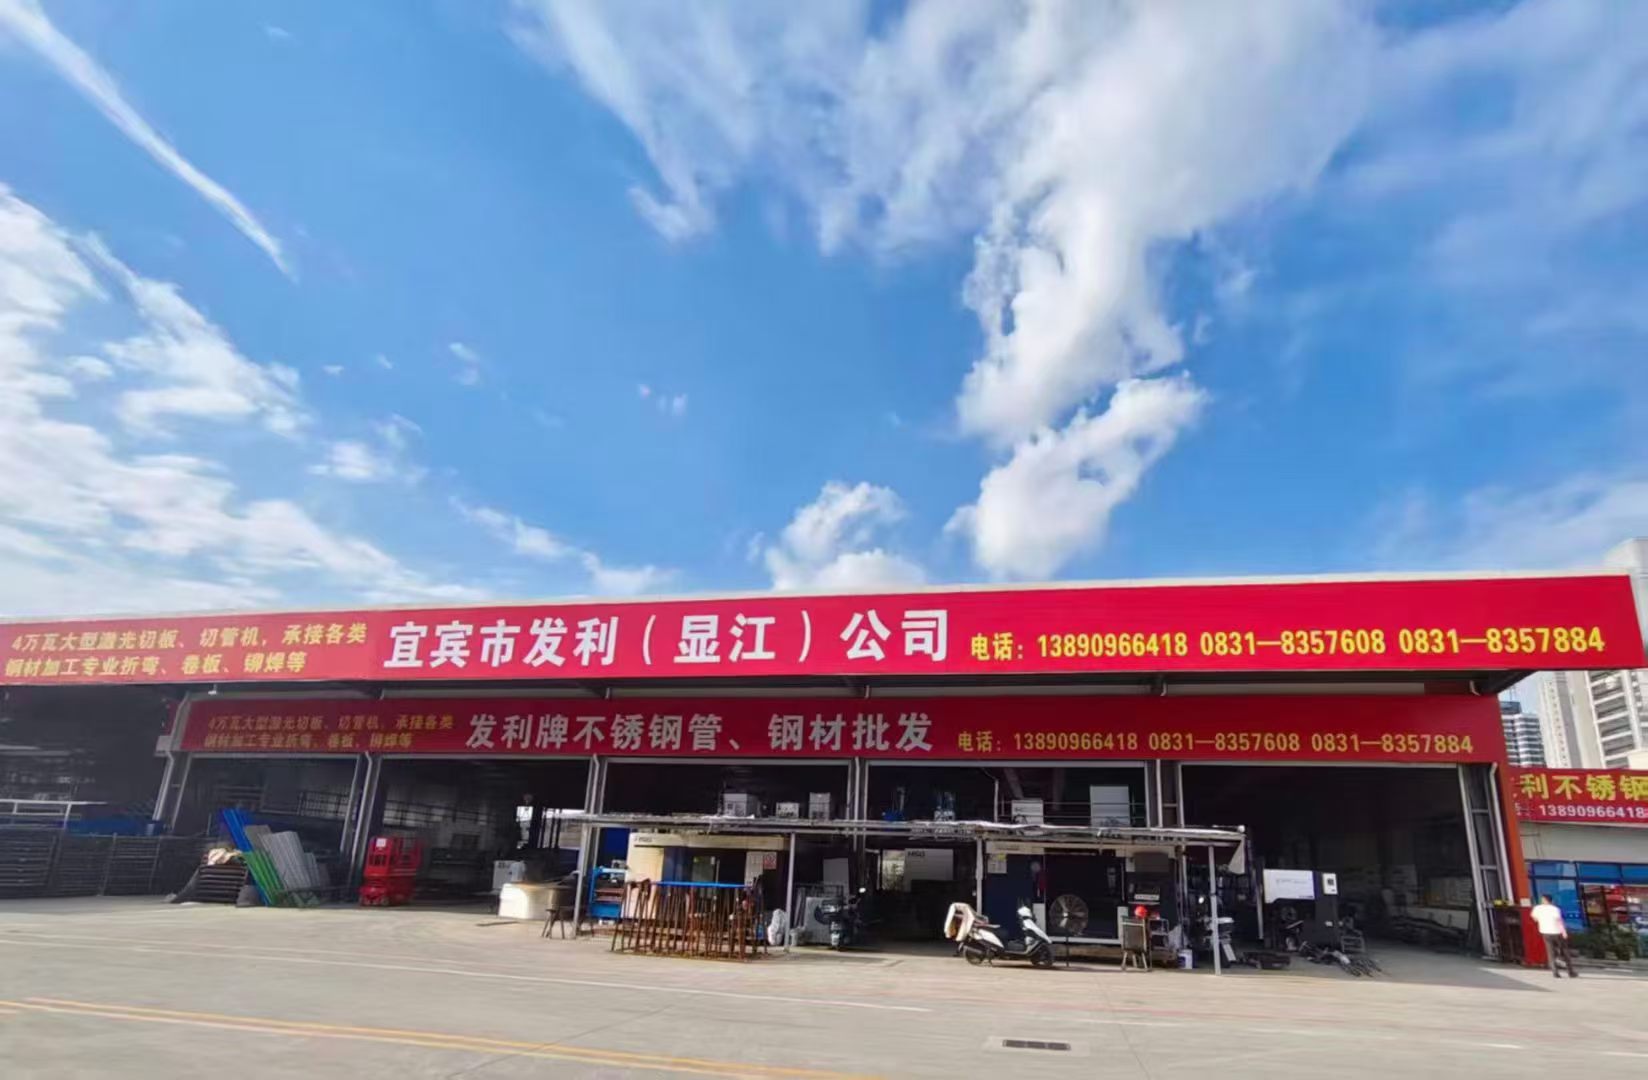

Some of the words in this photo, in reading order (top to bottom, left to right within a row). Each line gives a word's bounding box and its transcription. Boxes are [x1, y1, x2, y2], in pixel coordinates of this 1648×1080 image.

[384, 610, 947, 669] 宜宾市发利（显江）公司
[1037, 632, 1188, 658] 13890966418
[465, 713, 933, 752] 发利牌不锈钢管、钢材批发
[1014, 733, 1138, 751] 13890966418
[1511, 773, 1648, 800] 利不锈钢
